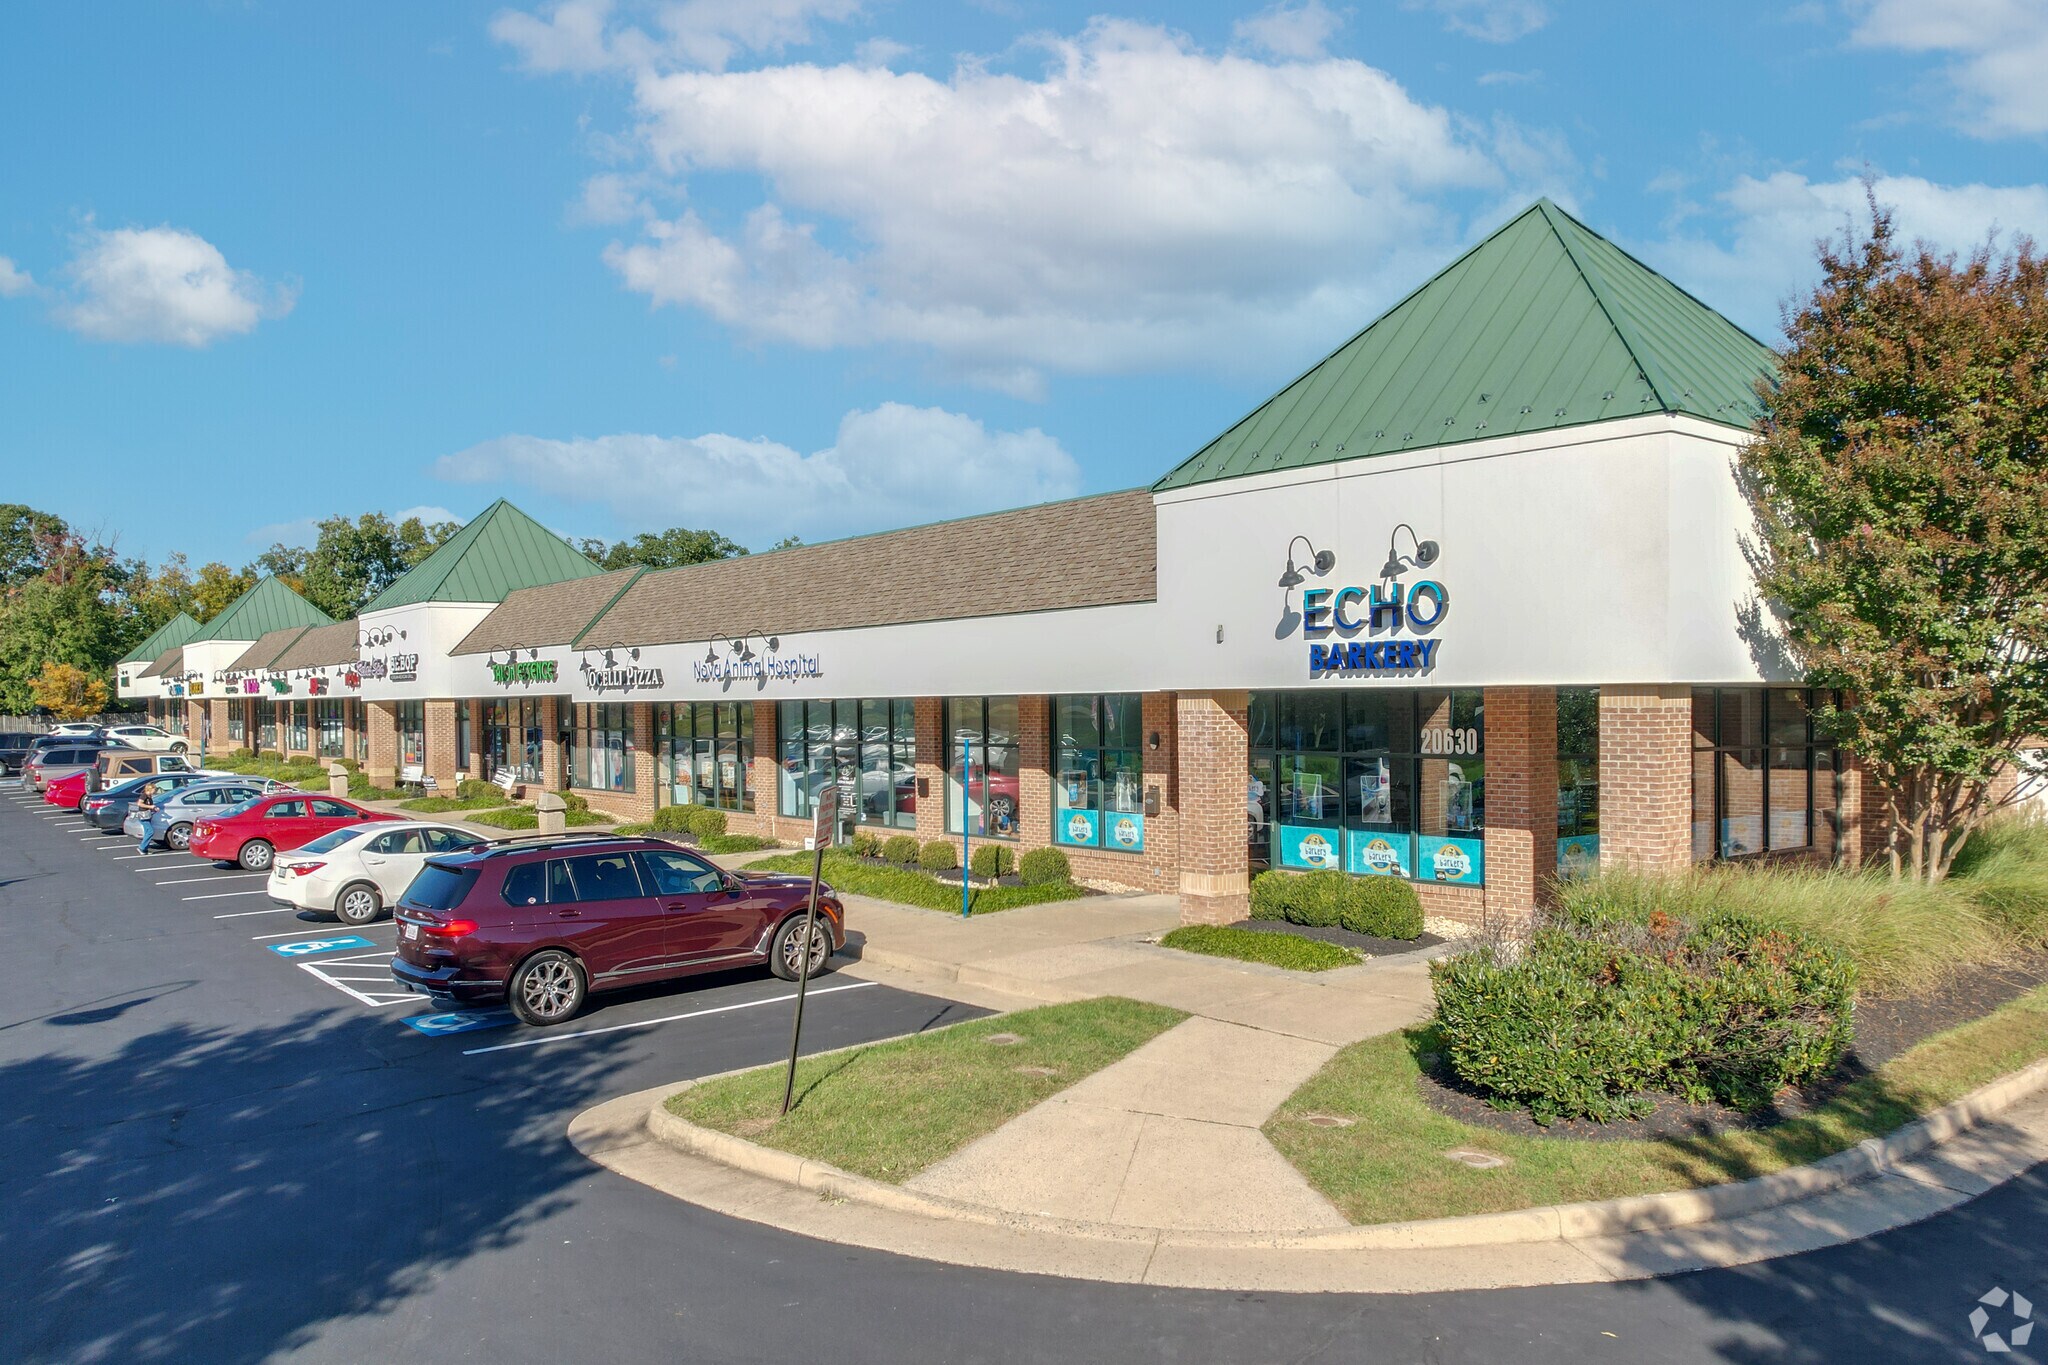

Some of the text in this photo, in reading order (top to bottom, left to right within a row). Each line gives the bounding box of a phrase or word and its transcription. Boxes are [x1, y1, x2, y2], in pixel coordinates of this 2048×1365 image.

[1304, 580, 1442, 631] ECHO
[390, 654, 416, 672] BEBOP
[693, 653, 820, 679] Nova Animal Hospital
[1310, 639, 1435, 671] BARKERY
[517, 660, 554, 682] ESSENCE
[584, 667, 623, 687] VOCELLI
[1420, 728, 1478, 755] 20630
[1368, 851, 1392, 863] barkery
